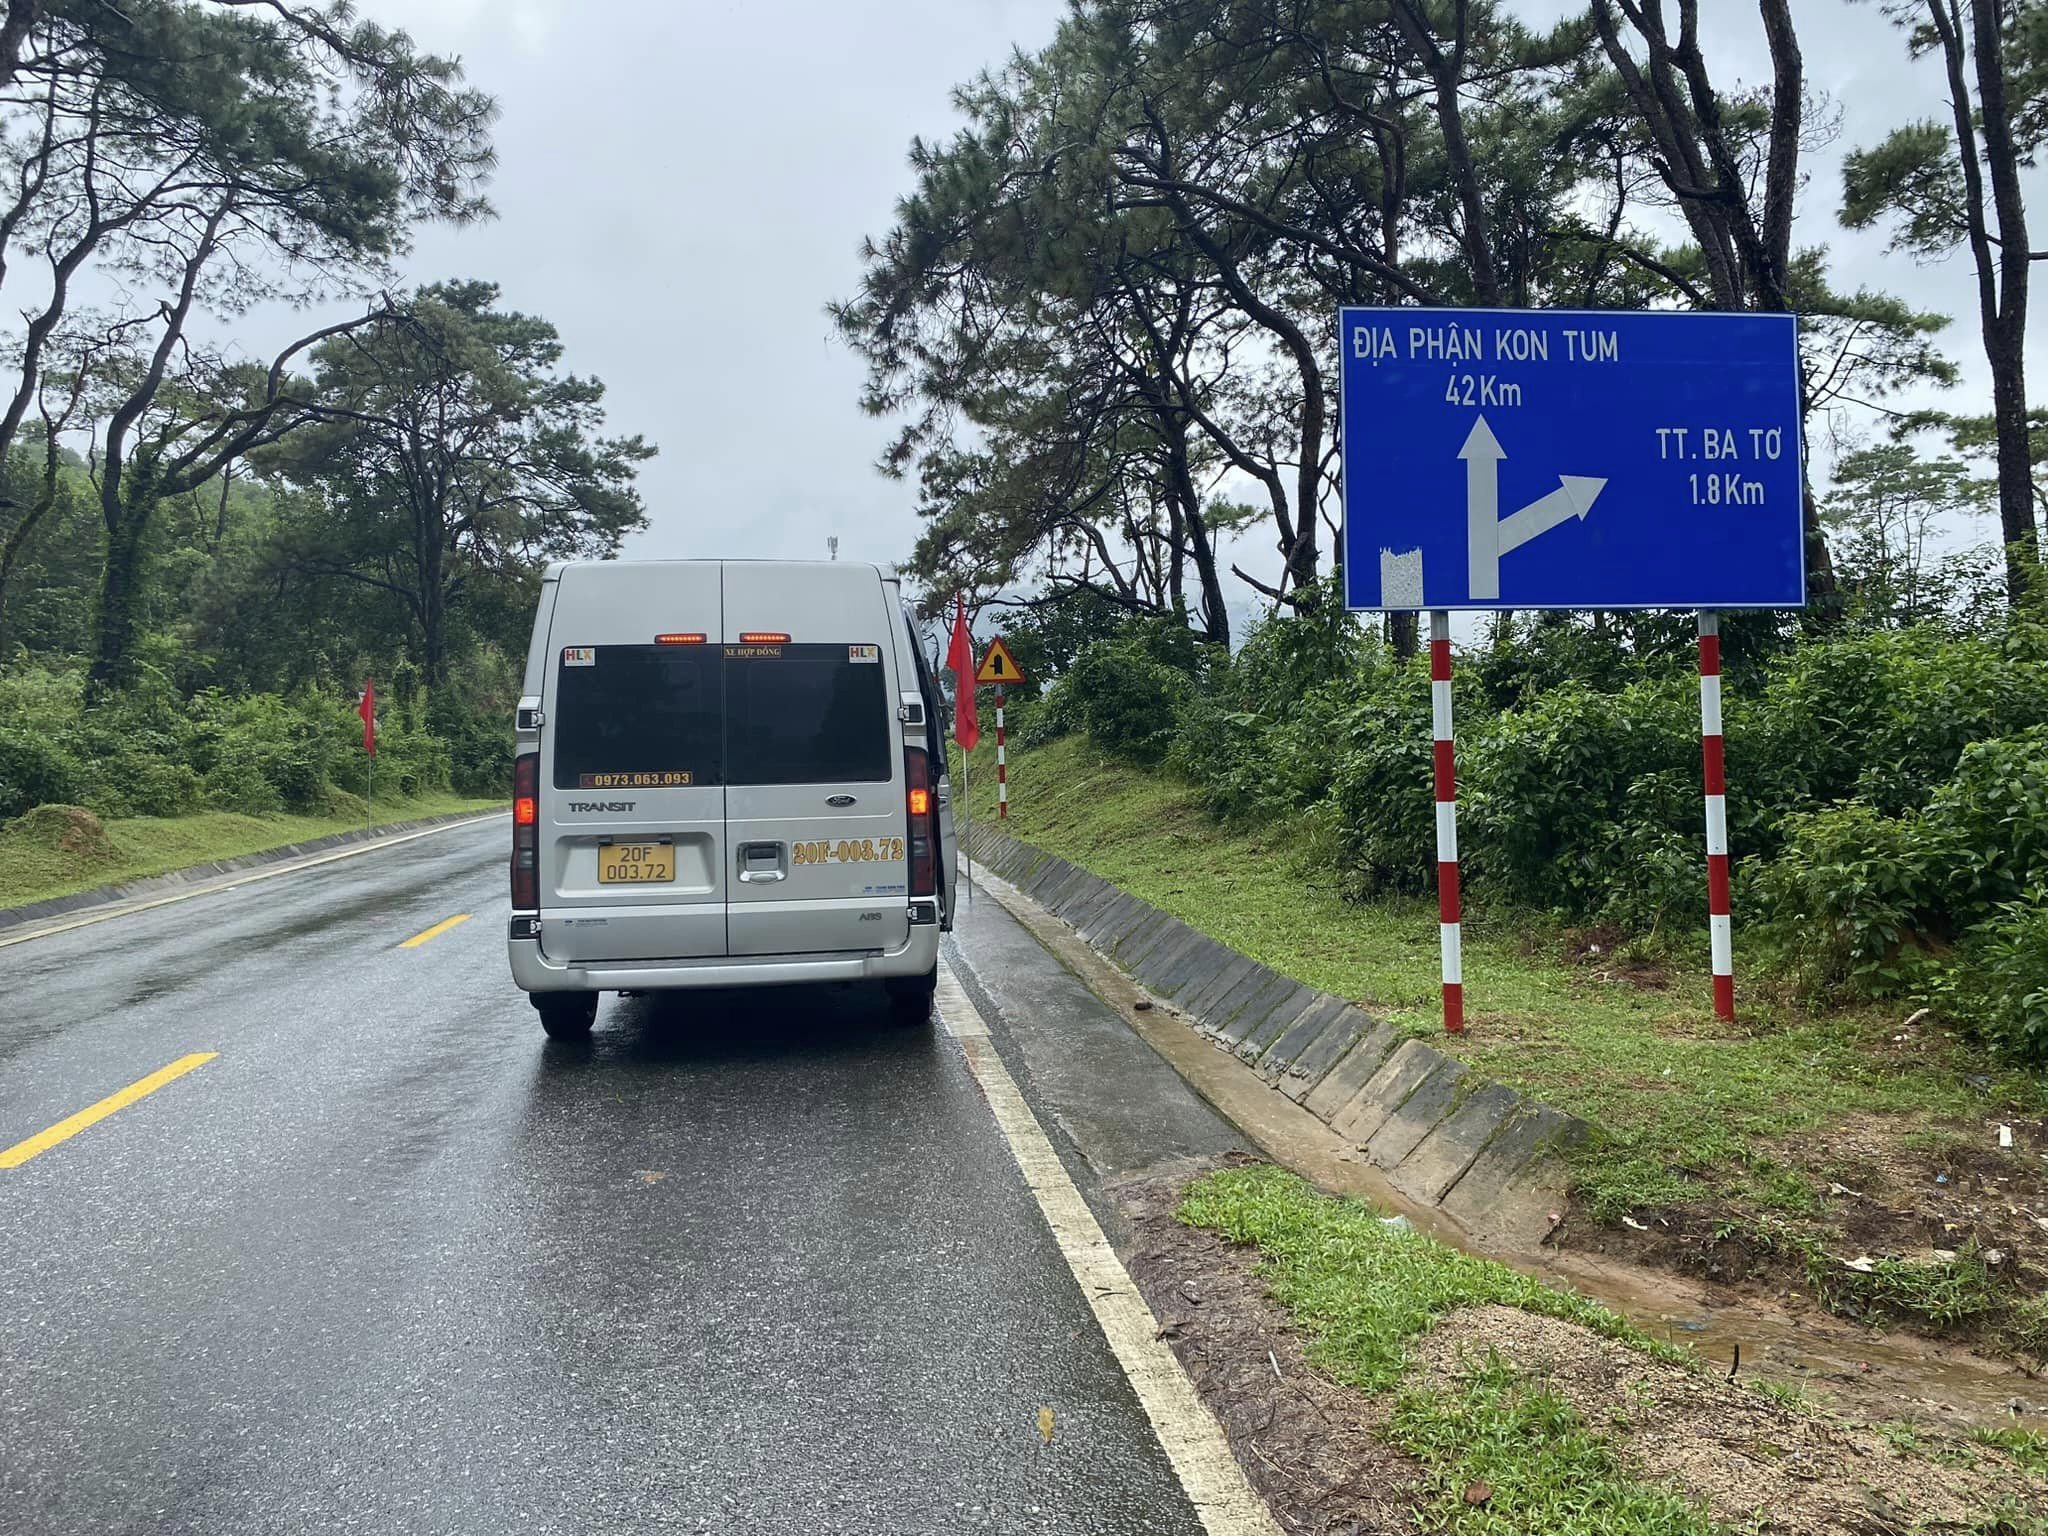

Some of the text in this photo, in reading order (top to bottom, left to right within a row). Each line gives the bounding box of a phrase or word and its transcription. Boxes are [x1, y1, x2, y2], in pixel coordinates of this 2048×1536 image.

[1353, 322, 1618, 367] ĐỊA PHẬN KON TUM
[1748, 426, 1782, 460] TƠ
[726, 648, 736, 656] XE
[595, 773, 690, 786] 0973.063.093
[568, 802, 636, 812] TRANSIT
[620, 847, 653, 862] 20F
[793, 838, 904, 865] 20F-003.72
[607, 864, 666, 880] 003.72
[859, 912, 882, 921] ABS
